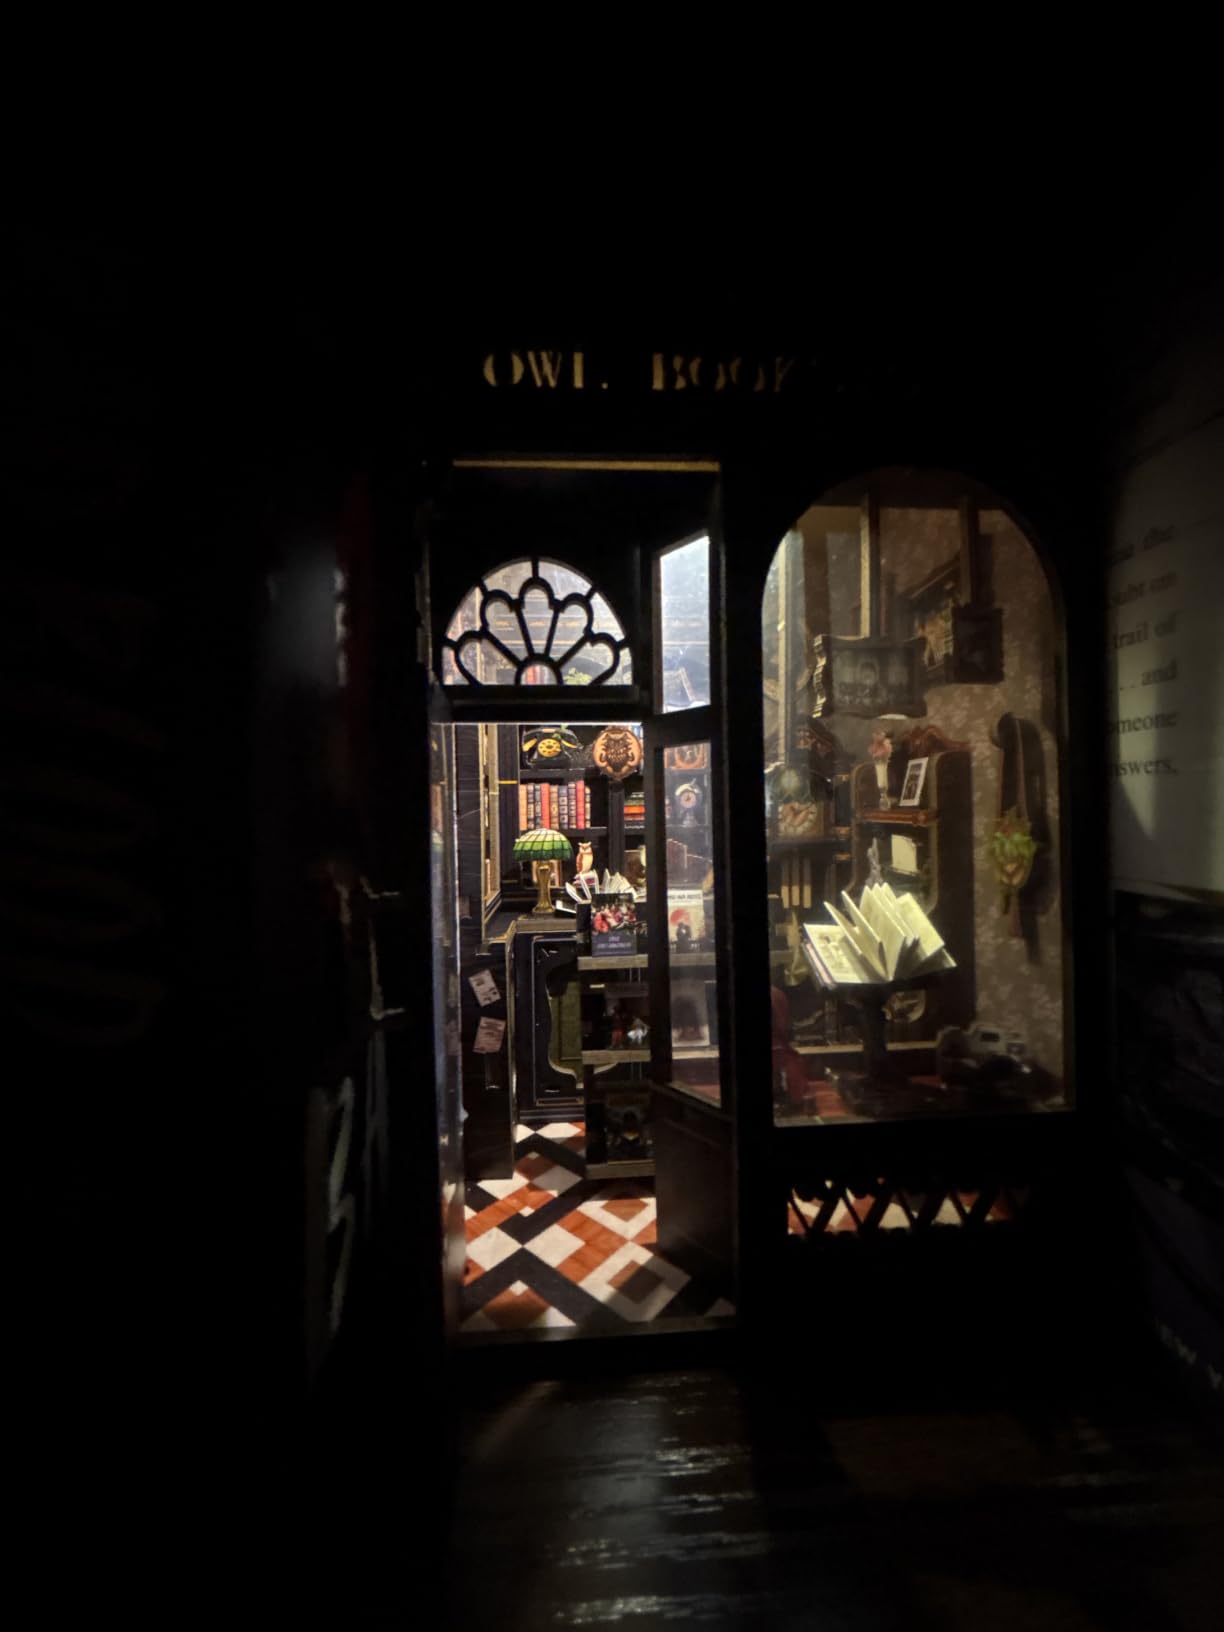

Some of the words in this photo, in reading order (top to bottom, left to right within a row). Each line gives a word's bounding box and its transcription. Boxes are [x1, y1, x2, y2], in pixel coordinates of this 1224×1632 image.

[1113, 621, 1149, 649] trail
[1154, 611, 1179, 637] of
[1141, 659, 1177, 686] and
[1104, 712, 1178, 735] omeone
